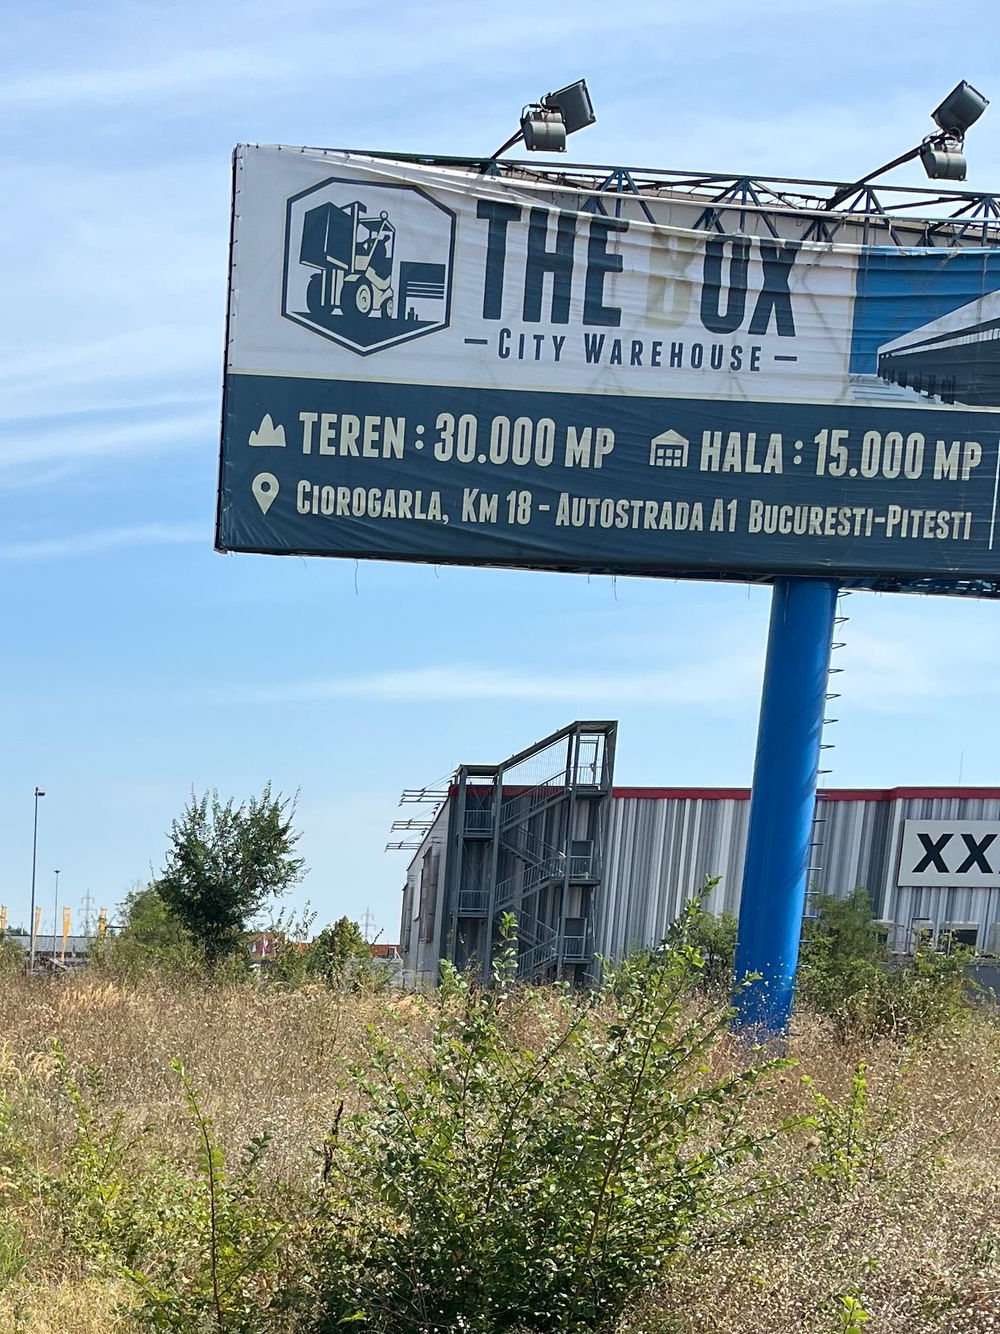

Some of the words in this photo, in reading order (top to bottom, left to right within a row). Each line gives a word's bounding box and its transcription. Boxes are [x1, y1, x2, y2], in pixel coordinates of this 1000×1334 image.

[476, 198, 630, 327] THE
[644, 230, 799, 337] BOX
[299, 411, 406, 459] TEREN
[433, 413, 556, 467] 30.000
[564, 426, 616, 469] MP
[699, 430, 783, 474] HALA
[814, 429, 926, 480] 15.000
[933, 440, 983, 481] MP
[506, 490, 533, 525] 18
[709, 499, 738, 532] A1
[912, 833, 1000, 874] XX
